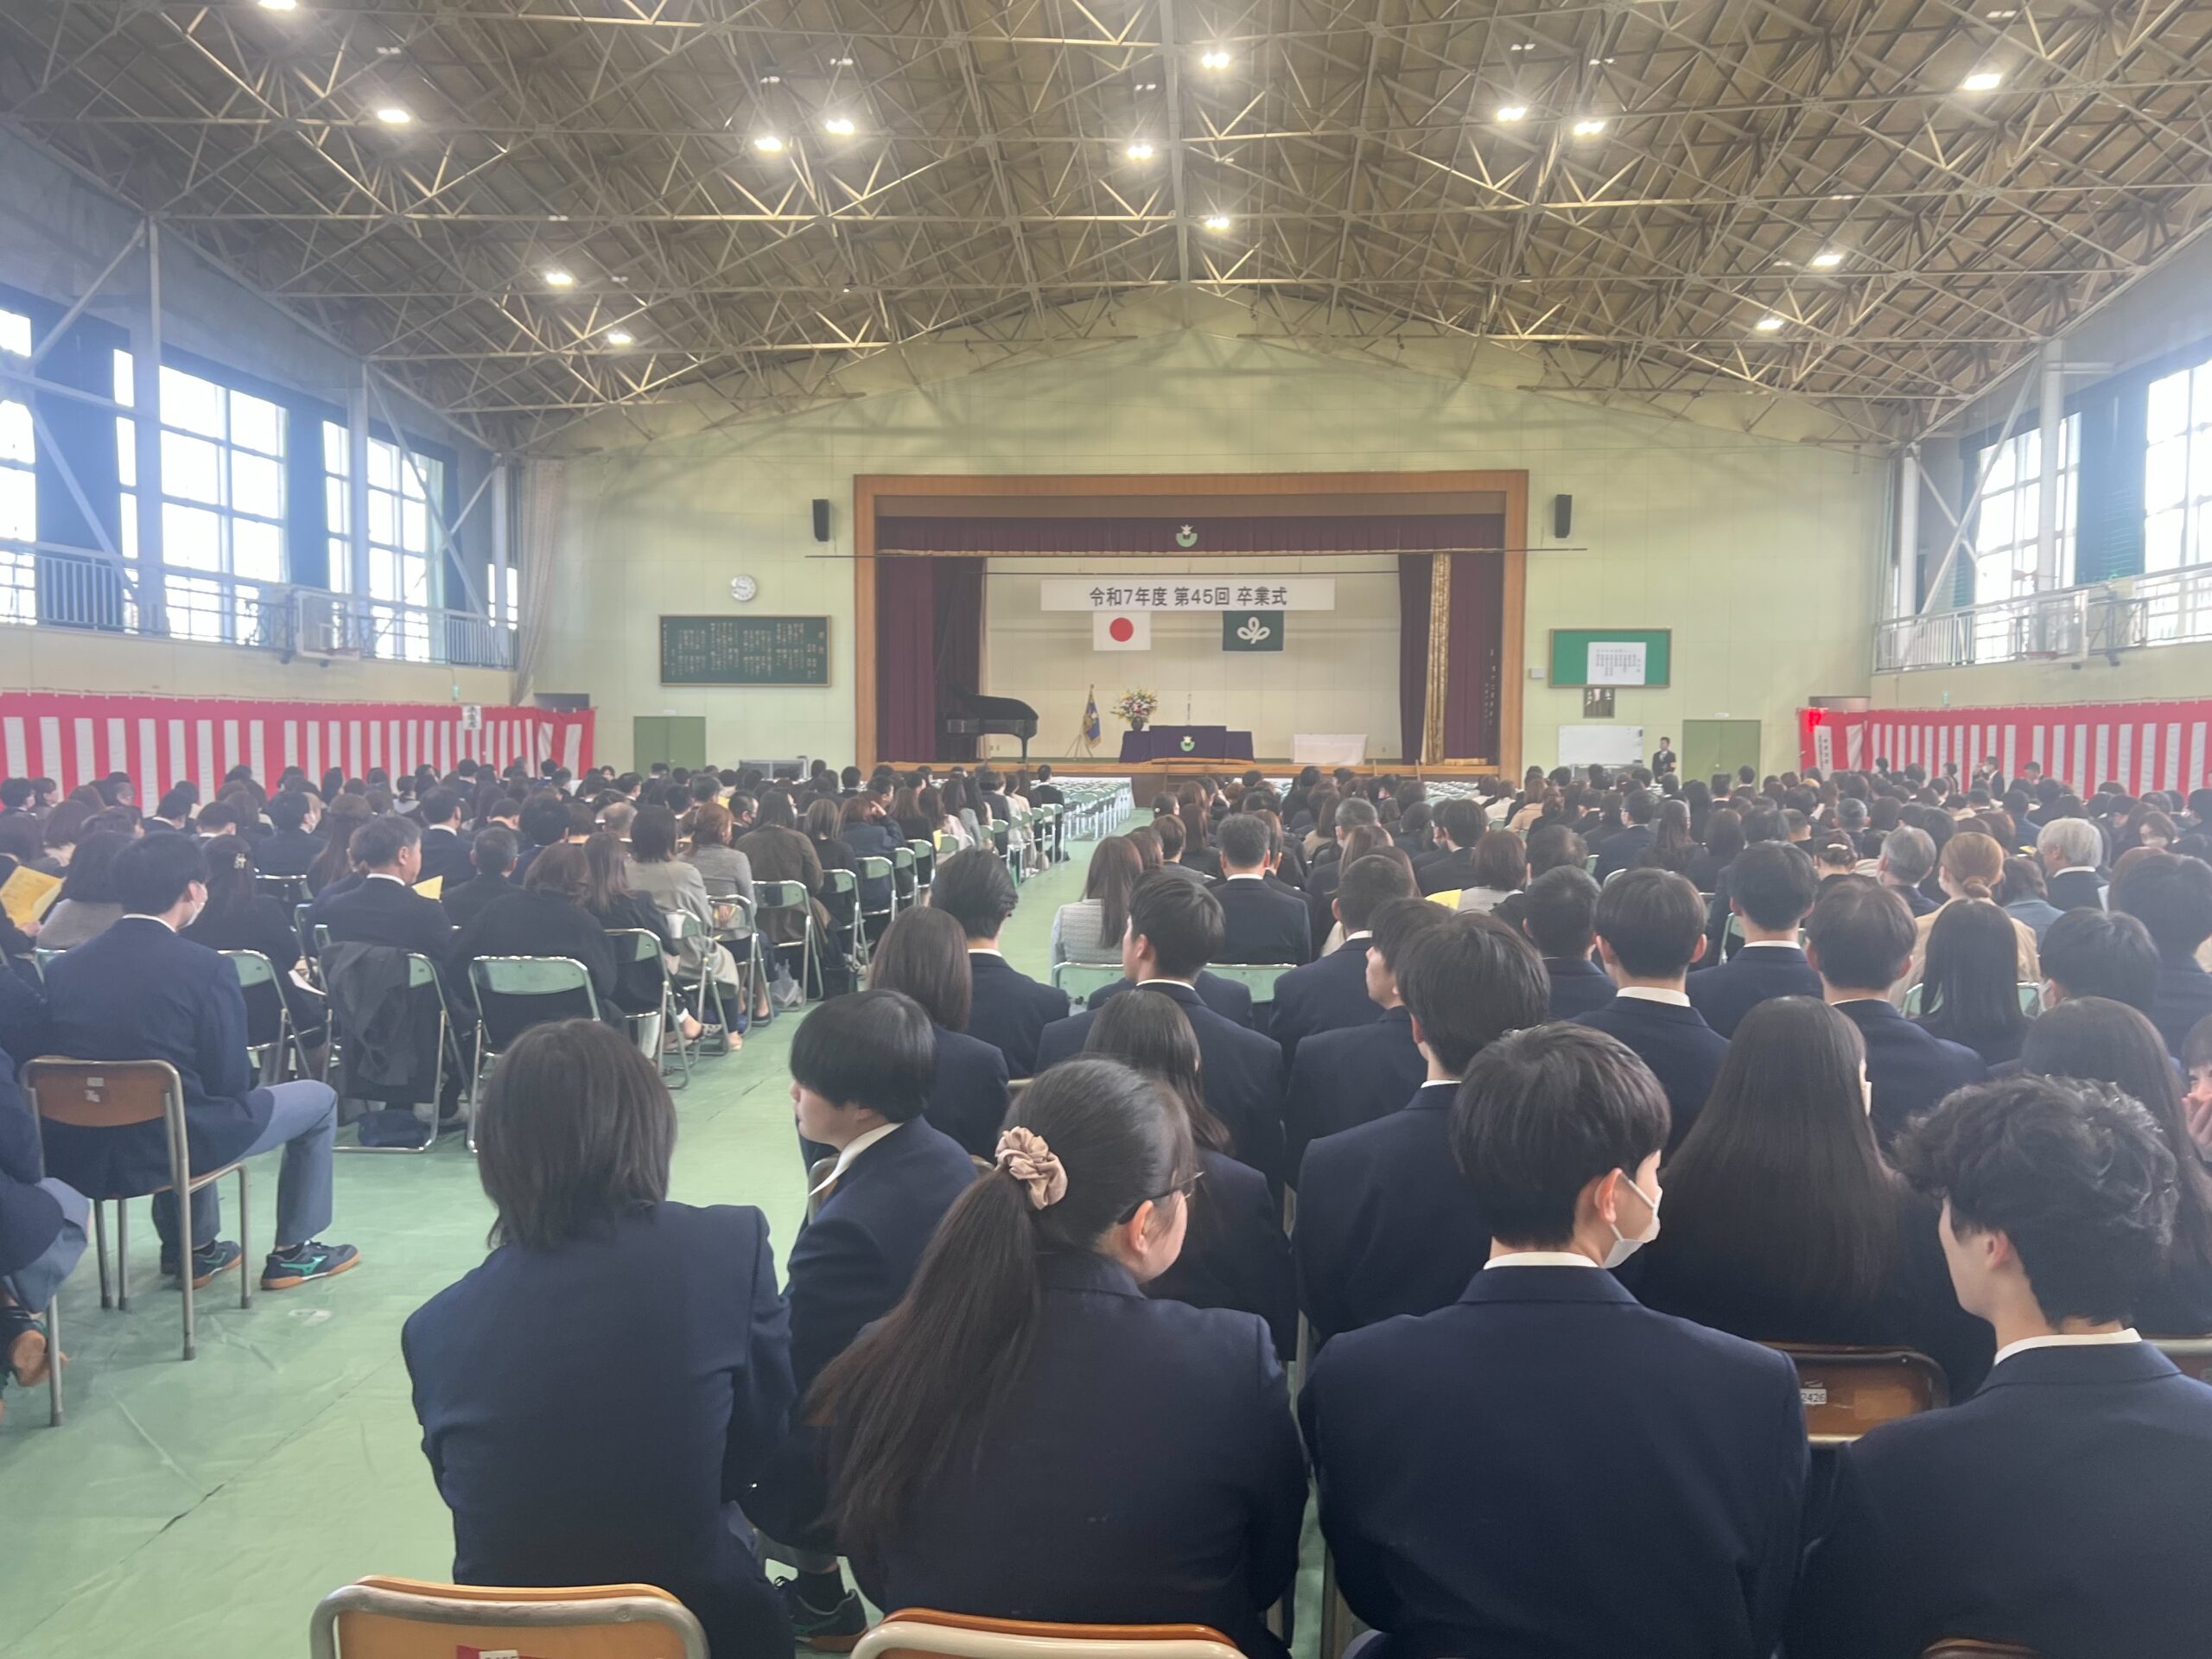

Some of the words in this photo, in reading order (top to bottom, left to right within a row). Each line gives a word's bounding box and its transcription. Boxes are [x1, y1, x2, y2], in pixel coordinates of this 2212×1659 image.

[1090, 587, 1168, 607] 令和7年度
[1173, 587, 1230, 607] 第45回
[1236, 586, 1287, 607] 卒業式
